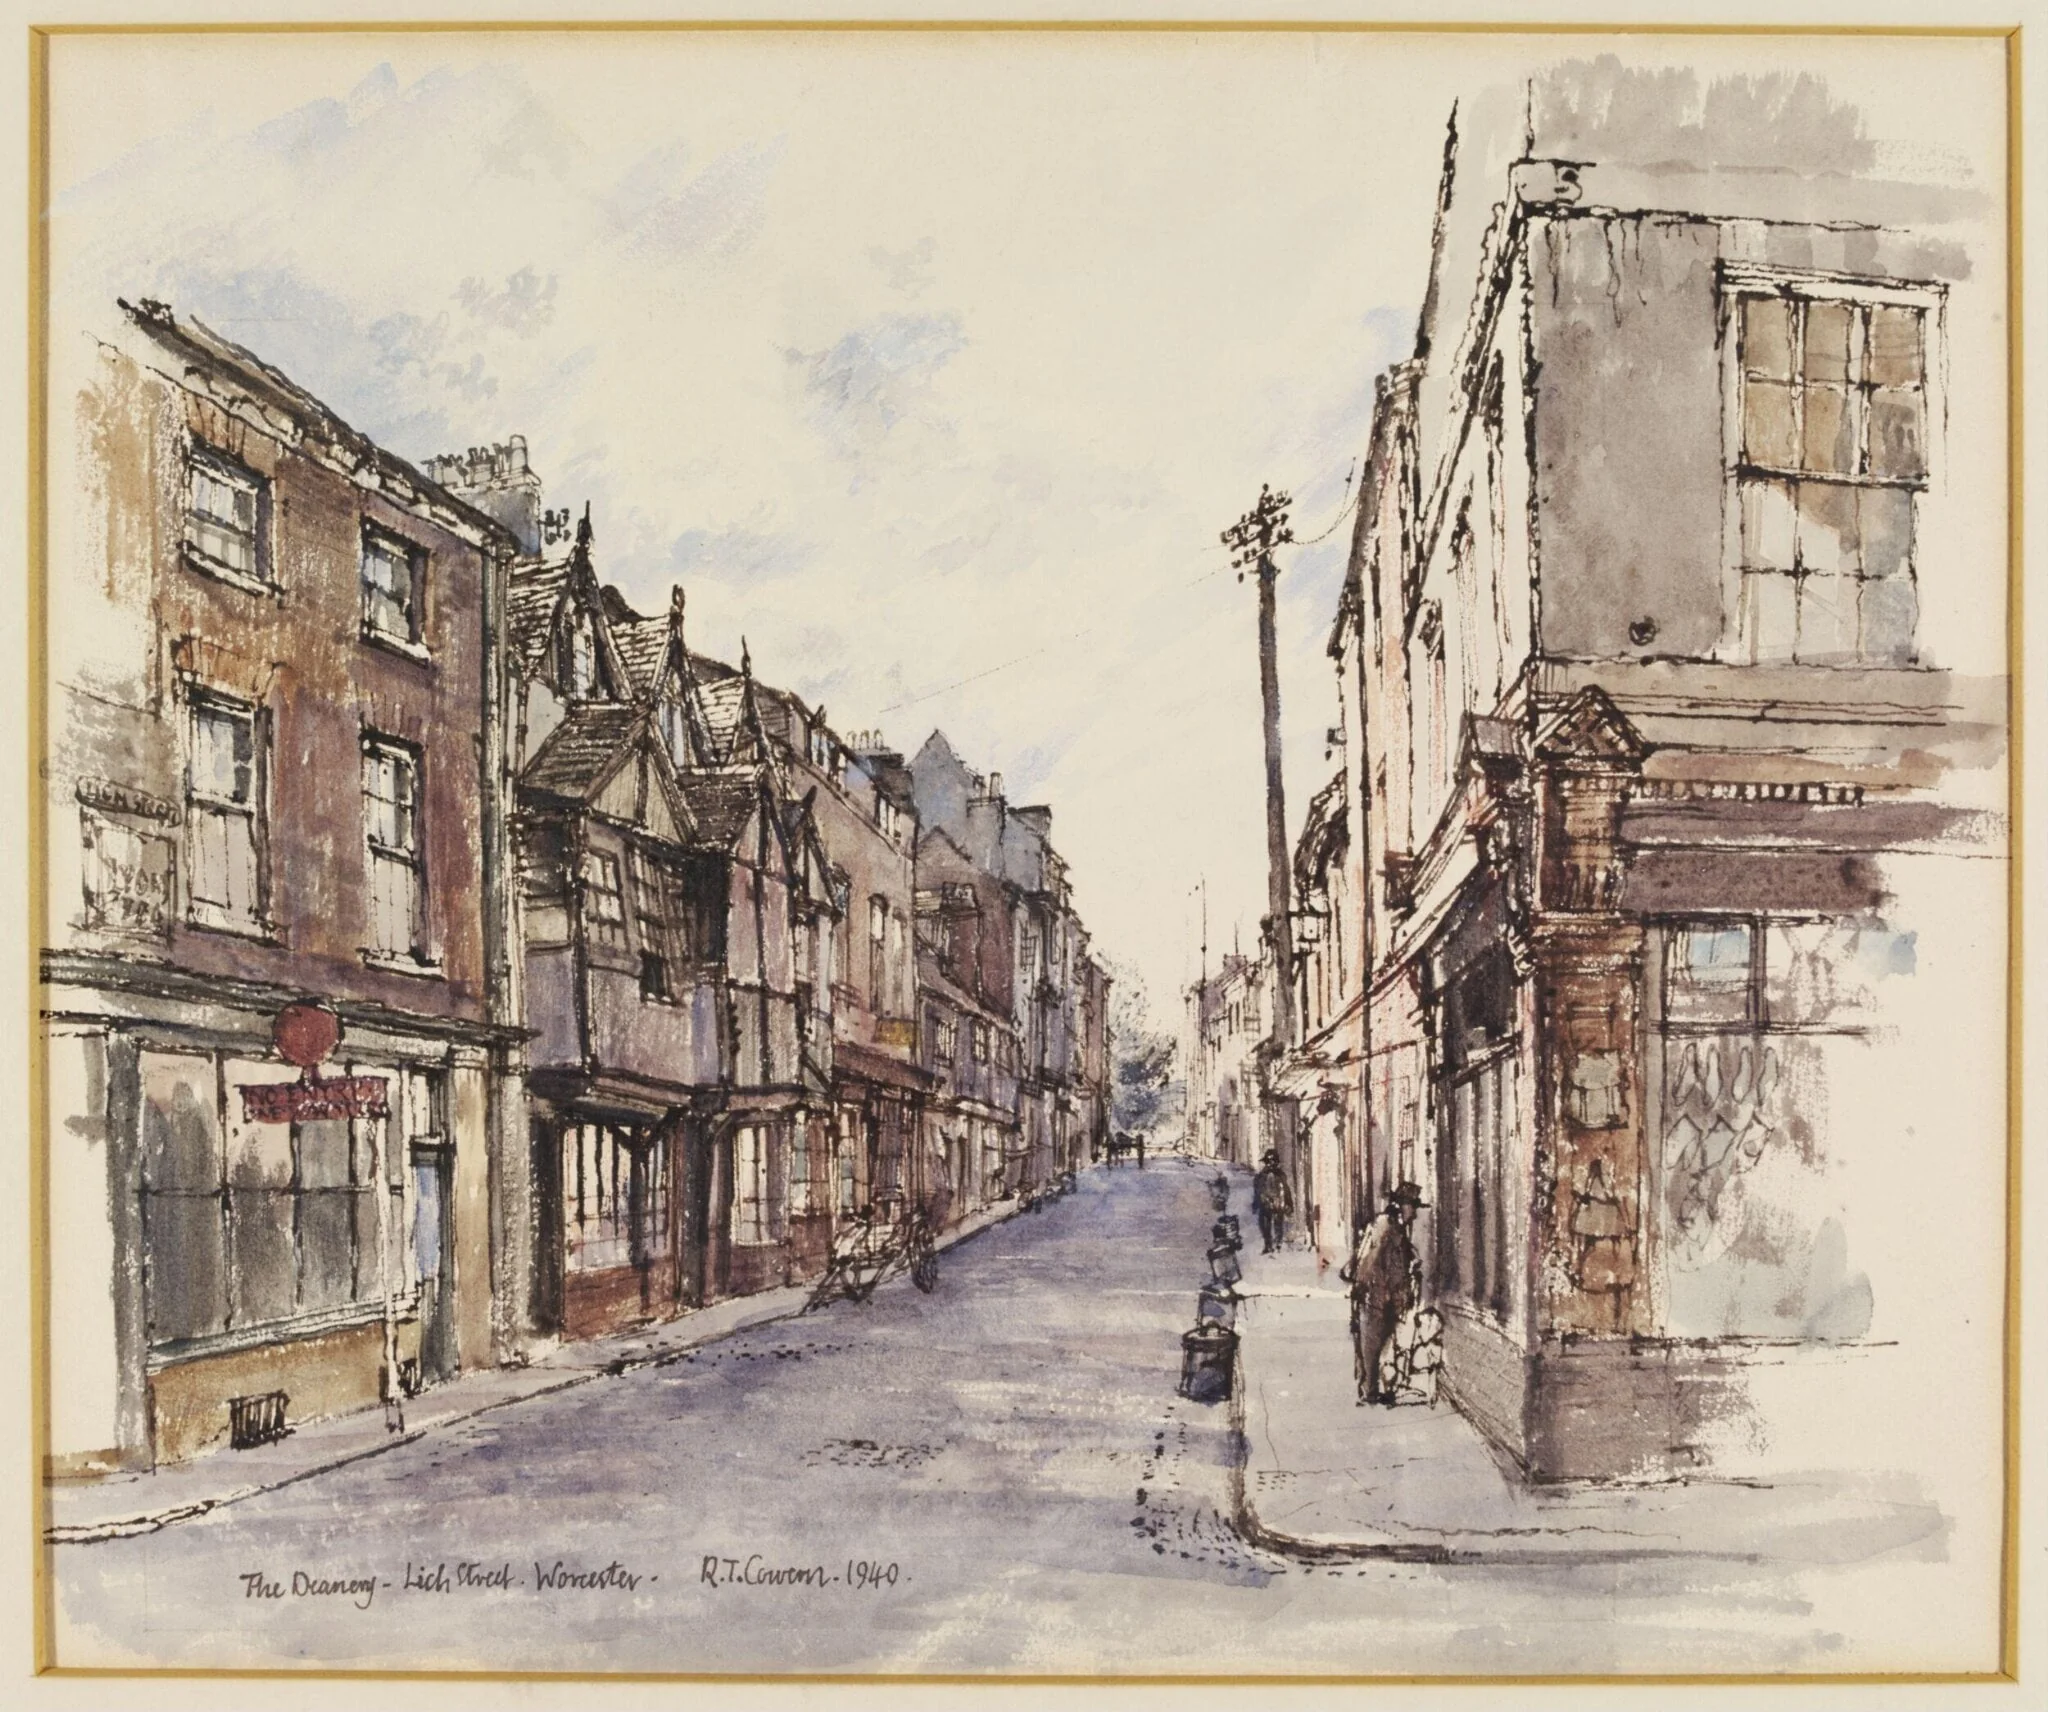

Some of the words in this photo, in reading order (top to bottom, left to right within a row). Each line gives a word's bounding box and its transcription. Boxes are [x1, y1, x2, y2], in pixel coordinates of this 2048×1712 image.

[238, 1571, 286, 1599] The
[291, 1570, 377, 1610] Deanery
[403, 1561, 450, 1594] Lich
